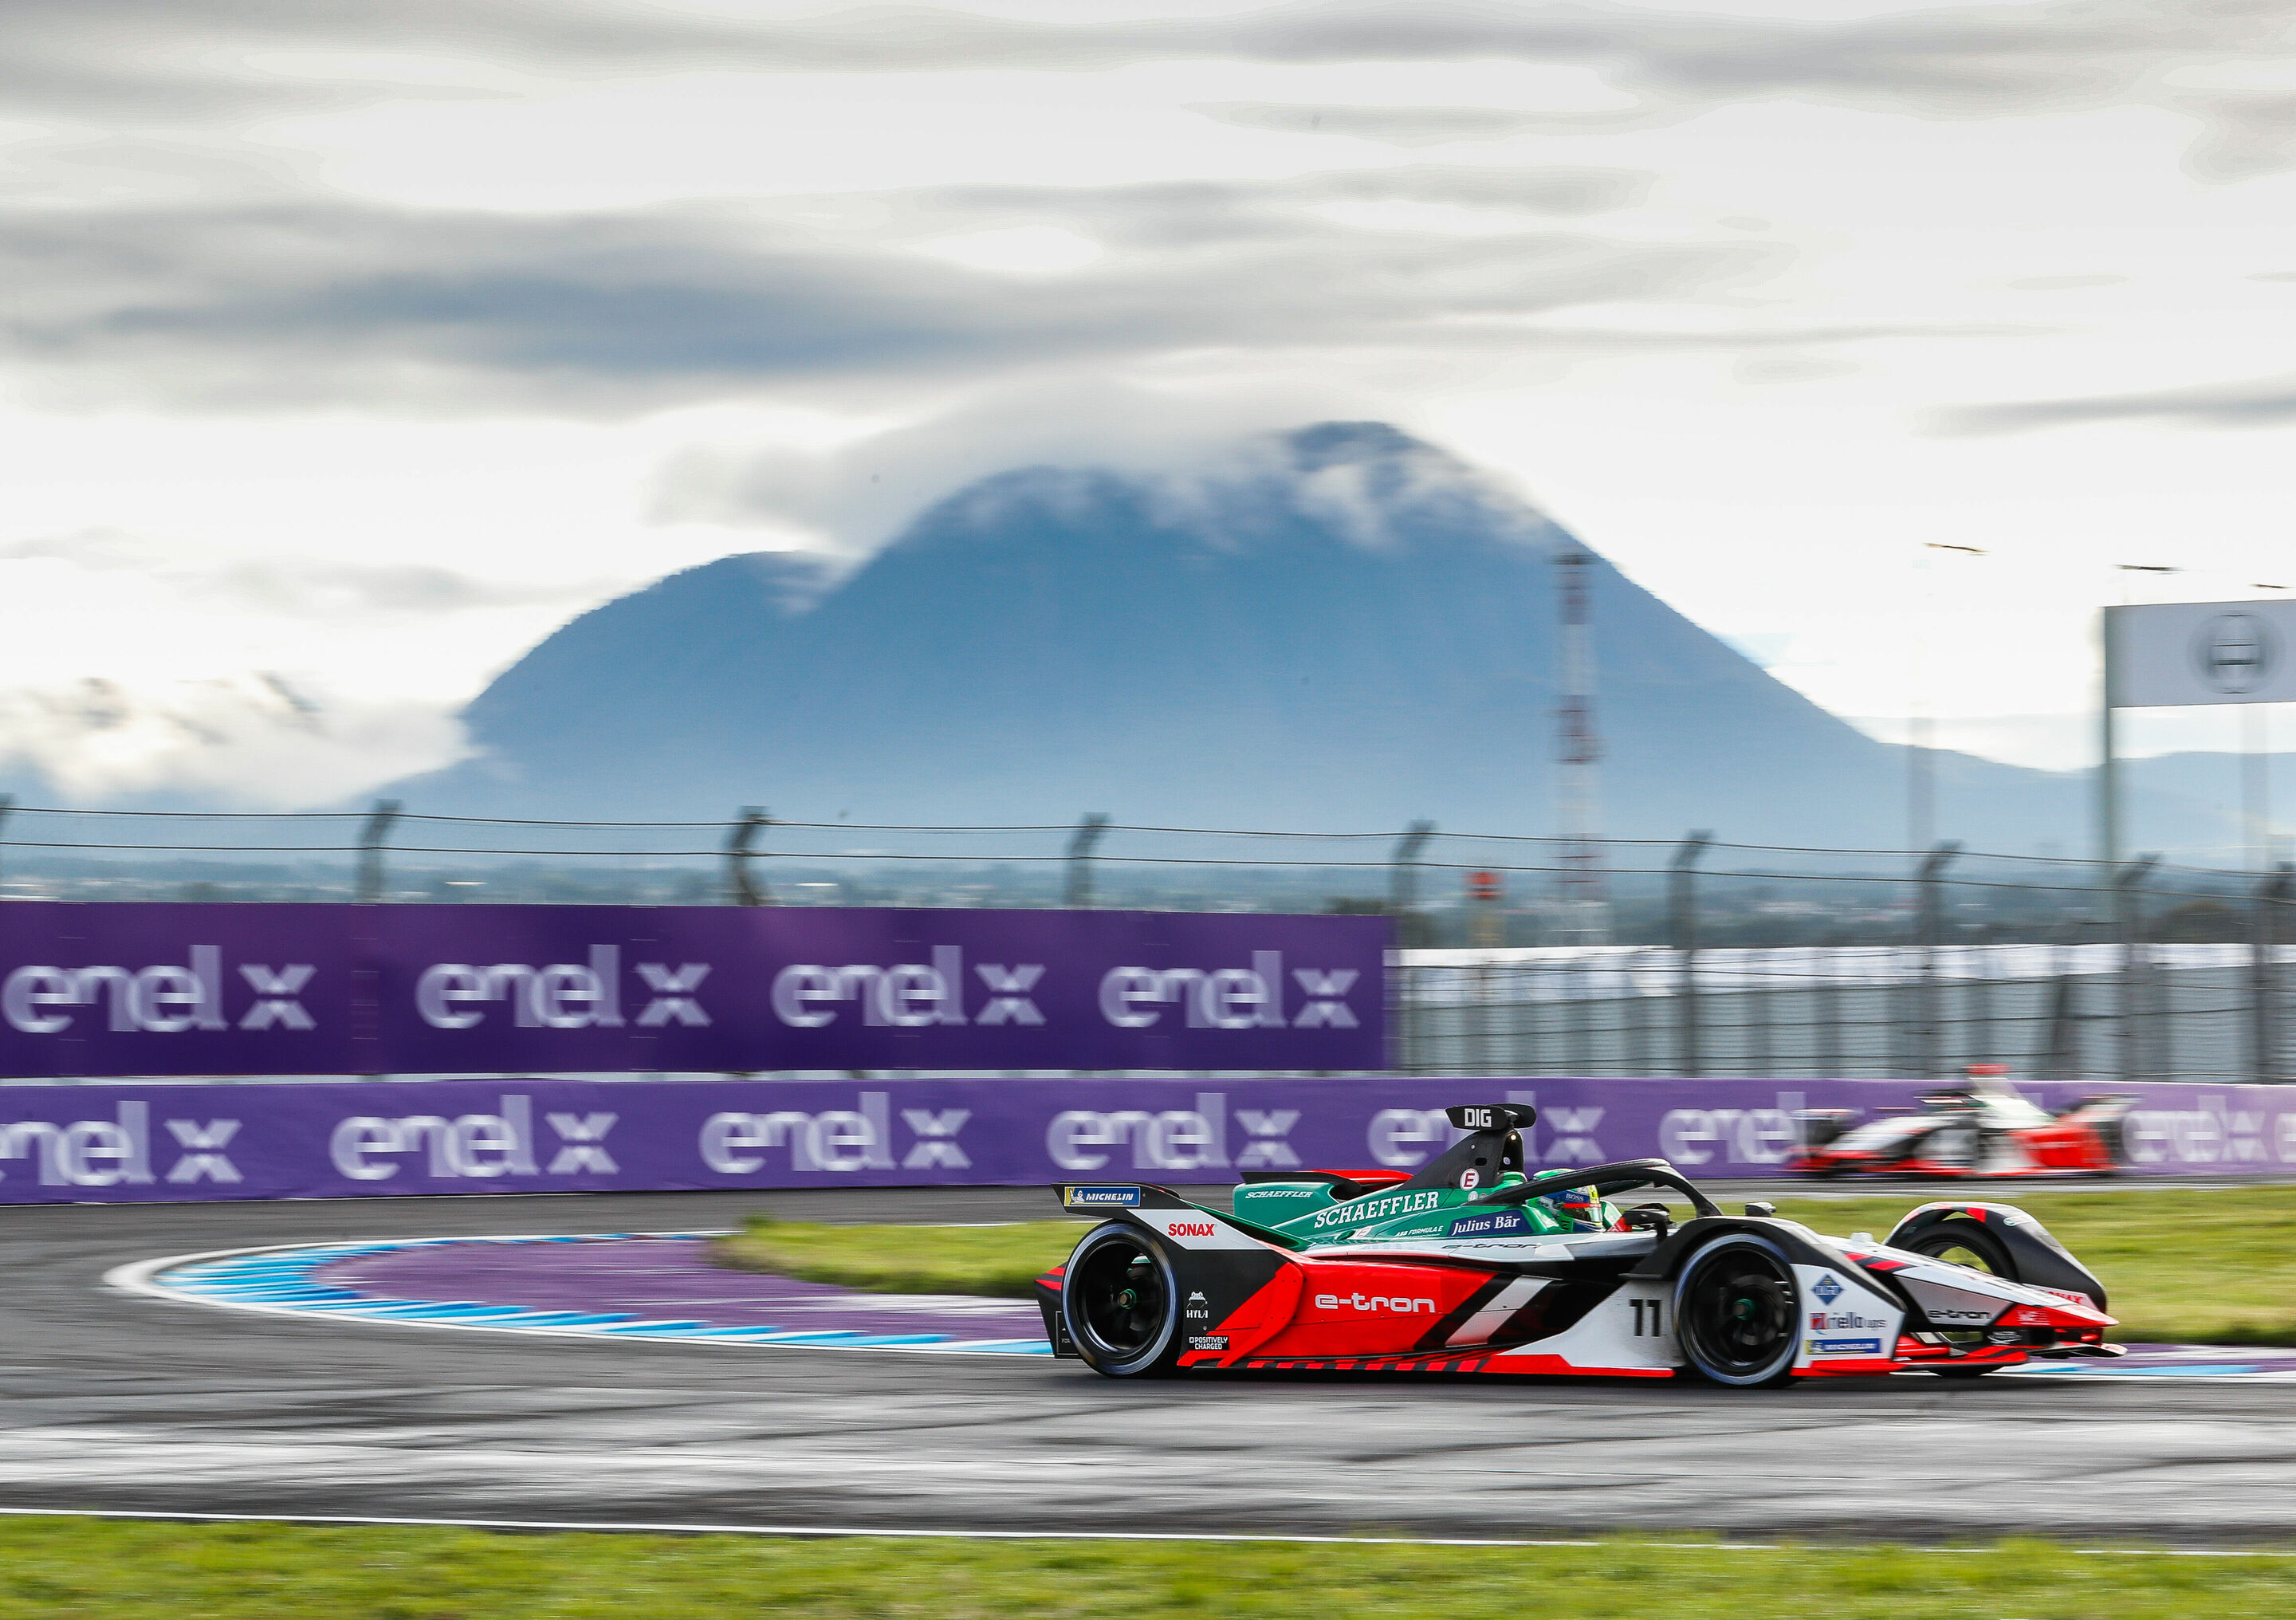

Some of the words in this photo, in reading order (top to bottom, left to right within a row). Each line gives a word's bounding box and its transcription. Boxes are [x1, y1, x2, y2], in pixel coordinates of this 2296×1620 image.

[2, 944, 227, 1033] enel
[238, 963, 318, 1031] x
[415, 944, 626, 1029] enel
[634, 962, 713, 1028] x
[771, 946, 968, 1028] enel
[975, 963, 1047, 1026] x
[1098, 950, 1288, 1029] enel
[1292, 968, 1360, 1028] x
[698, 1091, 895, 1174] enel
[901, 1108, 972, 1169] x
[1045, 1092, 1231, 1170] enel
[1233, 1108, 1303, 1168] x
[1464, 1107, 1492, 1127] DIG
[1542, 1107, 1606, 1163] x
[0, 1100, 157, 1186] nel
[163, 1119, 243, 1184] x
[328, 1095, 540, 1180] enel
[546, 1113, 620, 1175] x
[1085, 1192, 1134, 1201] MICHELIN
[1244, 1190, 1314, 1199] SCHAEFFLER
[1464, 1173, 1475, 1187] E
[1566, 1193, 1584, 1202] BOSS
[1314, 1191, 1439, 1229] SCHAEFFLER
[1451, 1220, 1491, 1236] Julius
[1494, 1216, 1520, 1229] Bär
[1168, 1223, 1217, 1237] SONAX
[1408, 1227, 1437, 1236] FORMULA
[1315, 1292, 1436, 1313] e-tron
[1629, 1299, 1662, 1337] 11
[1928, 1308, 1991, 1319] e-tron
